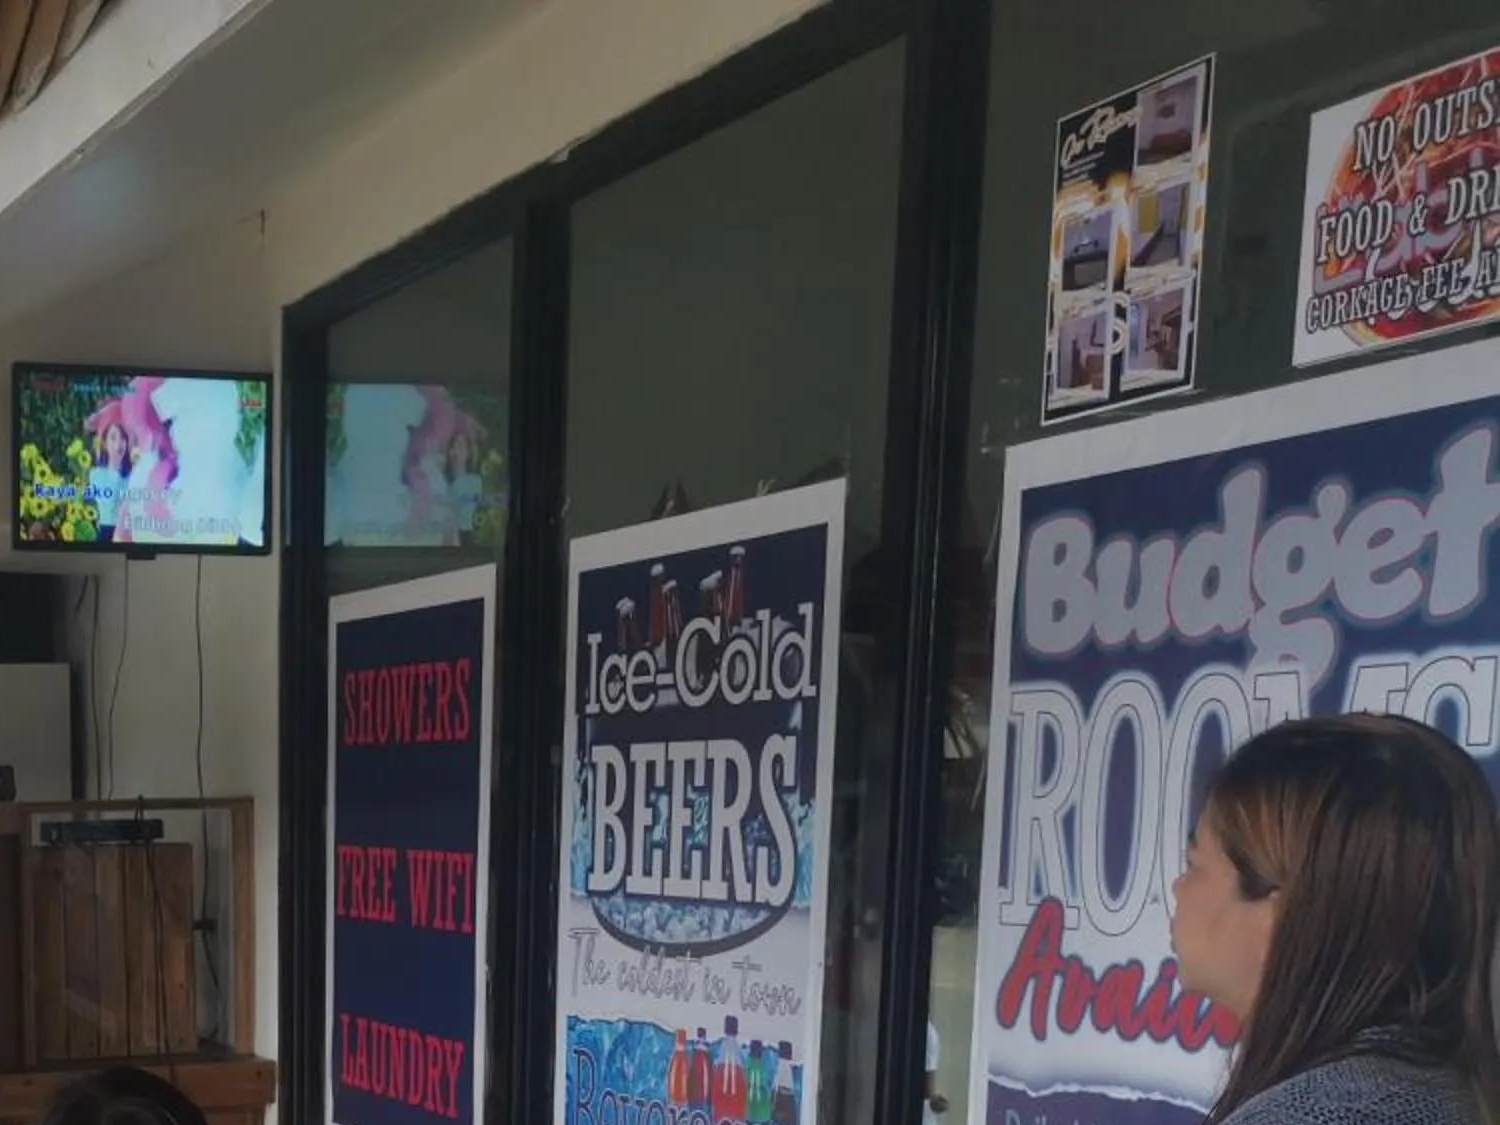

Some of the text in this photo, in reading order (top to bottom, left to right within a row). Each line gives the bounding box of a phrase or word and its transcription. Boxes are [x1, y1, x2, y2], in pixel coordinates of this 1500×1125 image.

[1353, 78, 1500, 173] NO OUTS
[1316, 198, 1395, 264] FOOD
[1408, 190, 1430, 238] &
[1304, 272, 1412, 335] CORKAGE
[1417, 256, 1466, 303] FEE
[1476, 246, 1500, 296] A
[1020, 422, 1500, 690] Budget
[342, 656, 473, 747] SHOWERS
[585, 601, 818, 716] Ice-Cold
[587, 732, 799, 908] BEERS
[998, 655, 1500, 938] ROO
[336, 843, 475, 935] FREE WIFI
[567, 927, 611, 998] The
[615, 945, 700, 1003] coldest
[732, 955, 803, 1016] Town
[339, 1012, 466, 1119] LAUNDRY
